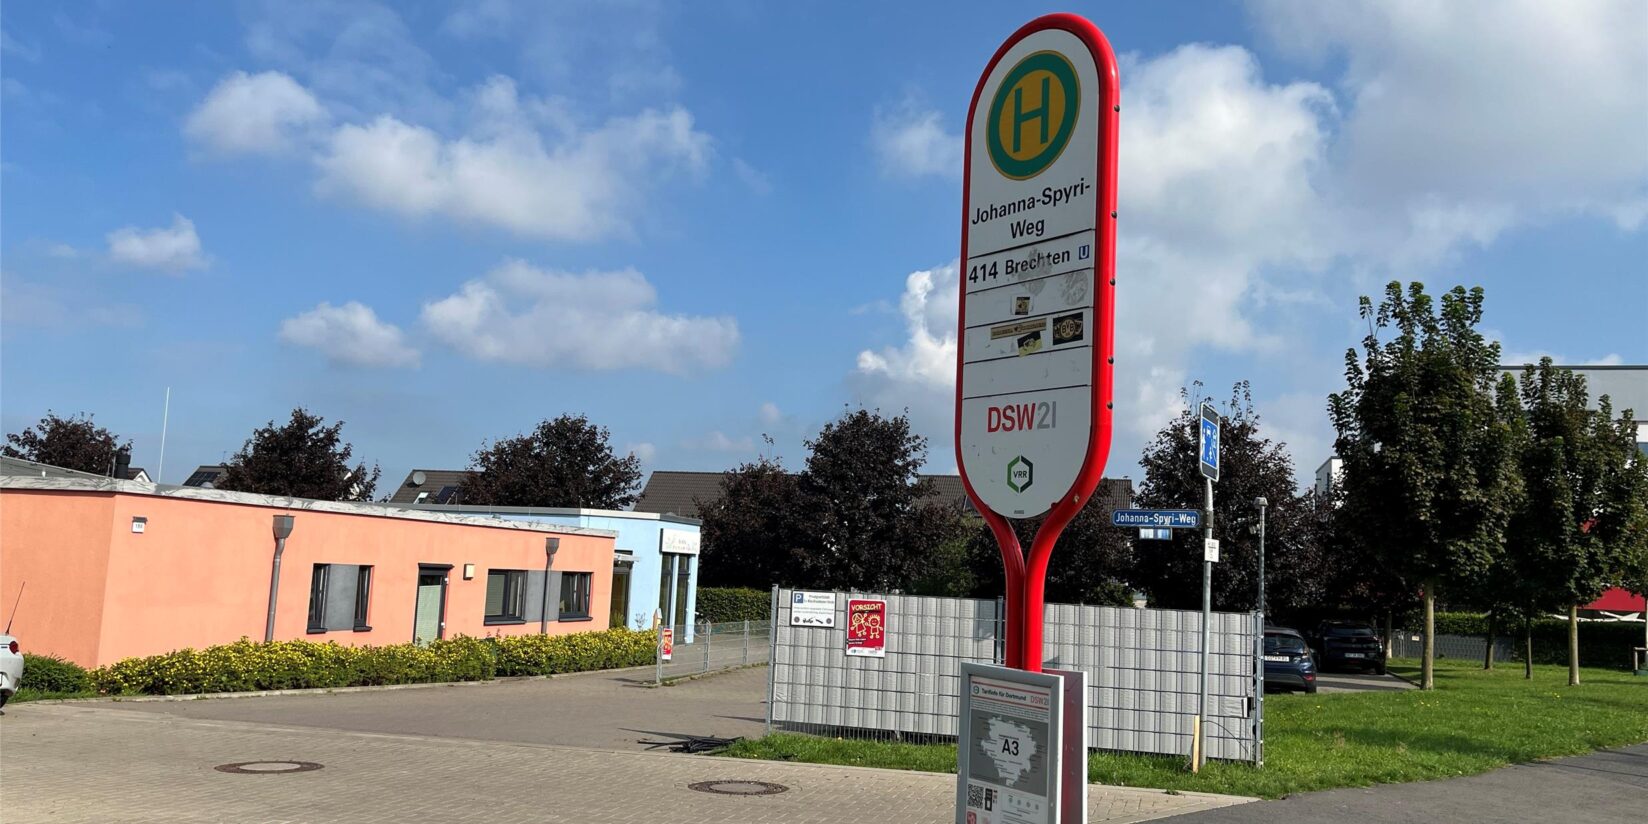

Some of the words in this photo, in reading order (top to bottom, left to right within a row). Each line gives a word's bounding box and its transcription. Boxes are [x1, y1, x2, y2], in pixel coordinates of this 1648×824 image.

[1013, 77, 1050, 153] H
[972, 178, 1091, 225] Johanna-Spyri-
[1010, 219, 1045, 239] Weg
[969, 261, 998, 283] 414
[1005, 250, 1070, 275] Brechten
[987, 401, 1056, 433] DSW21
[1013, 470, 1028, 479] VRR
[1115, 513, 1196, 526] Johanna-Spyri-Weg
[795, 594, 802, 602] P
[851, 603, 882, 611] VORSICHT
[1005, 691, 1026, 702] Dortmund
[1002, 739, 1019, 756] A3
